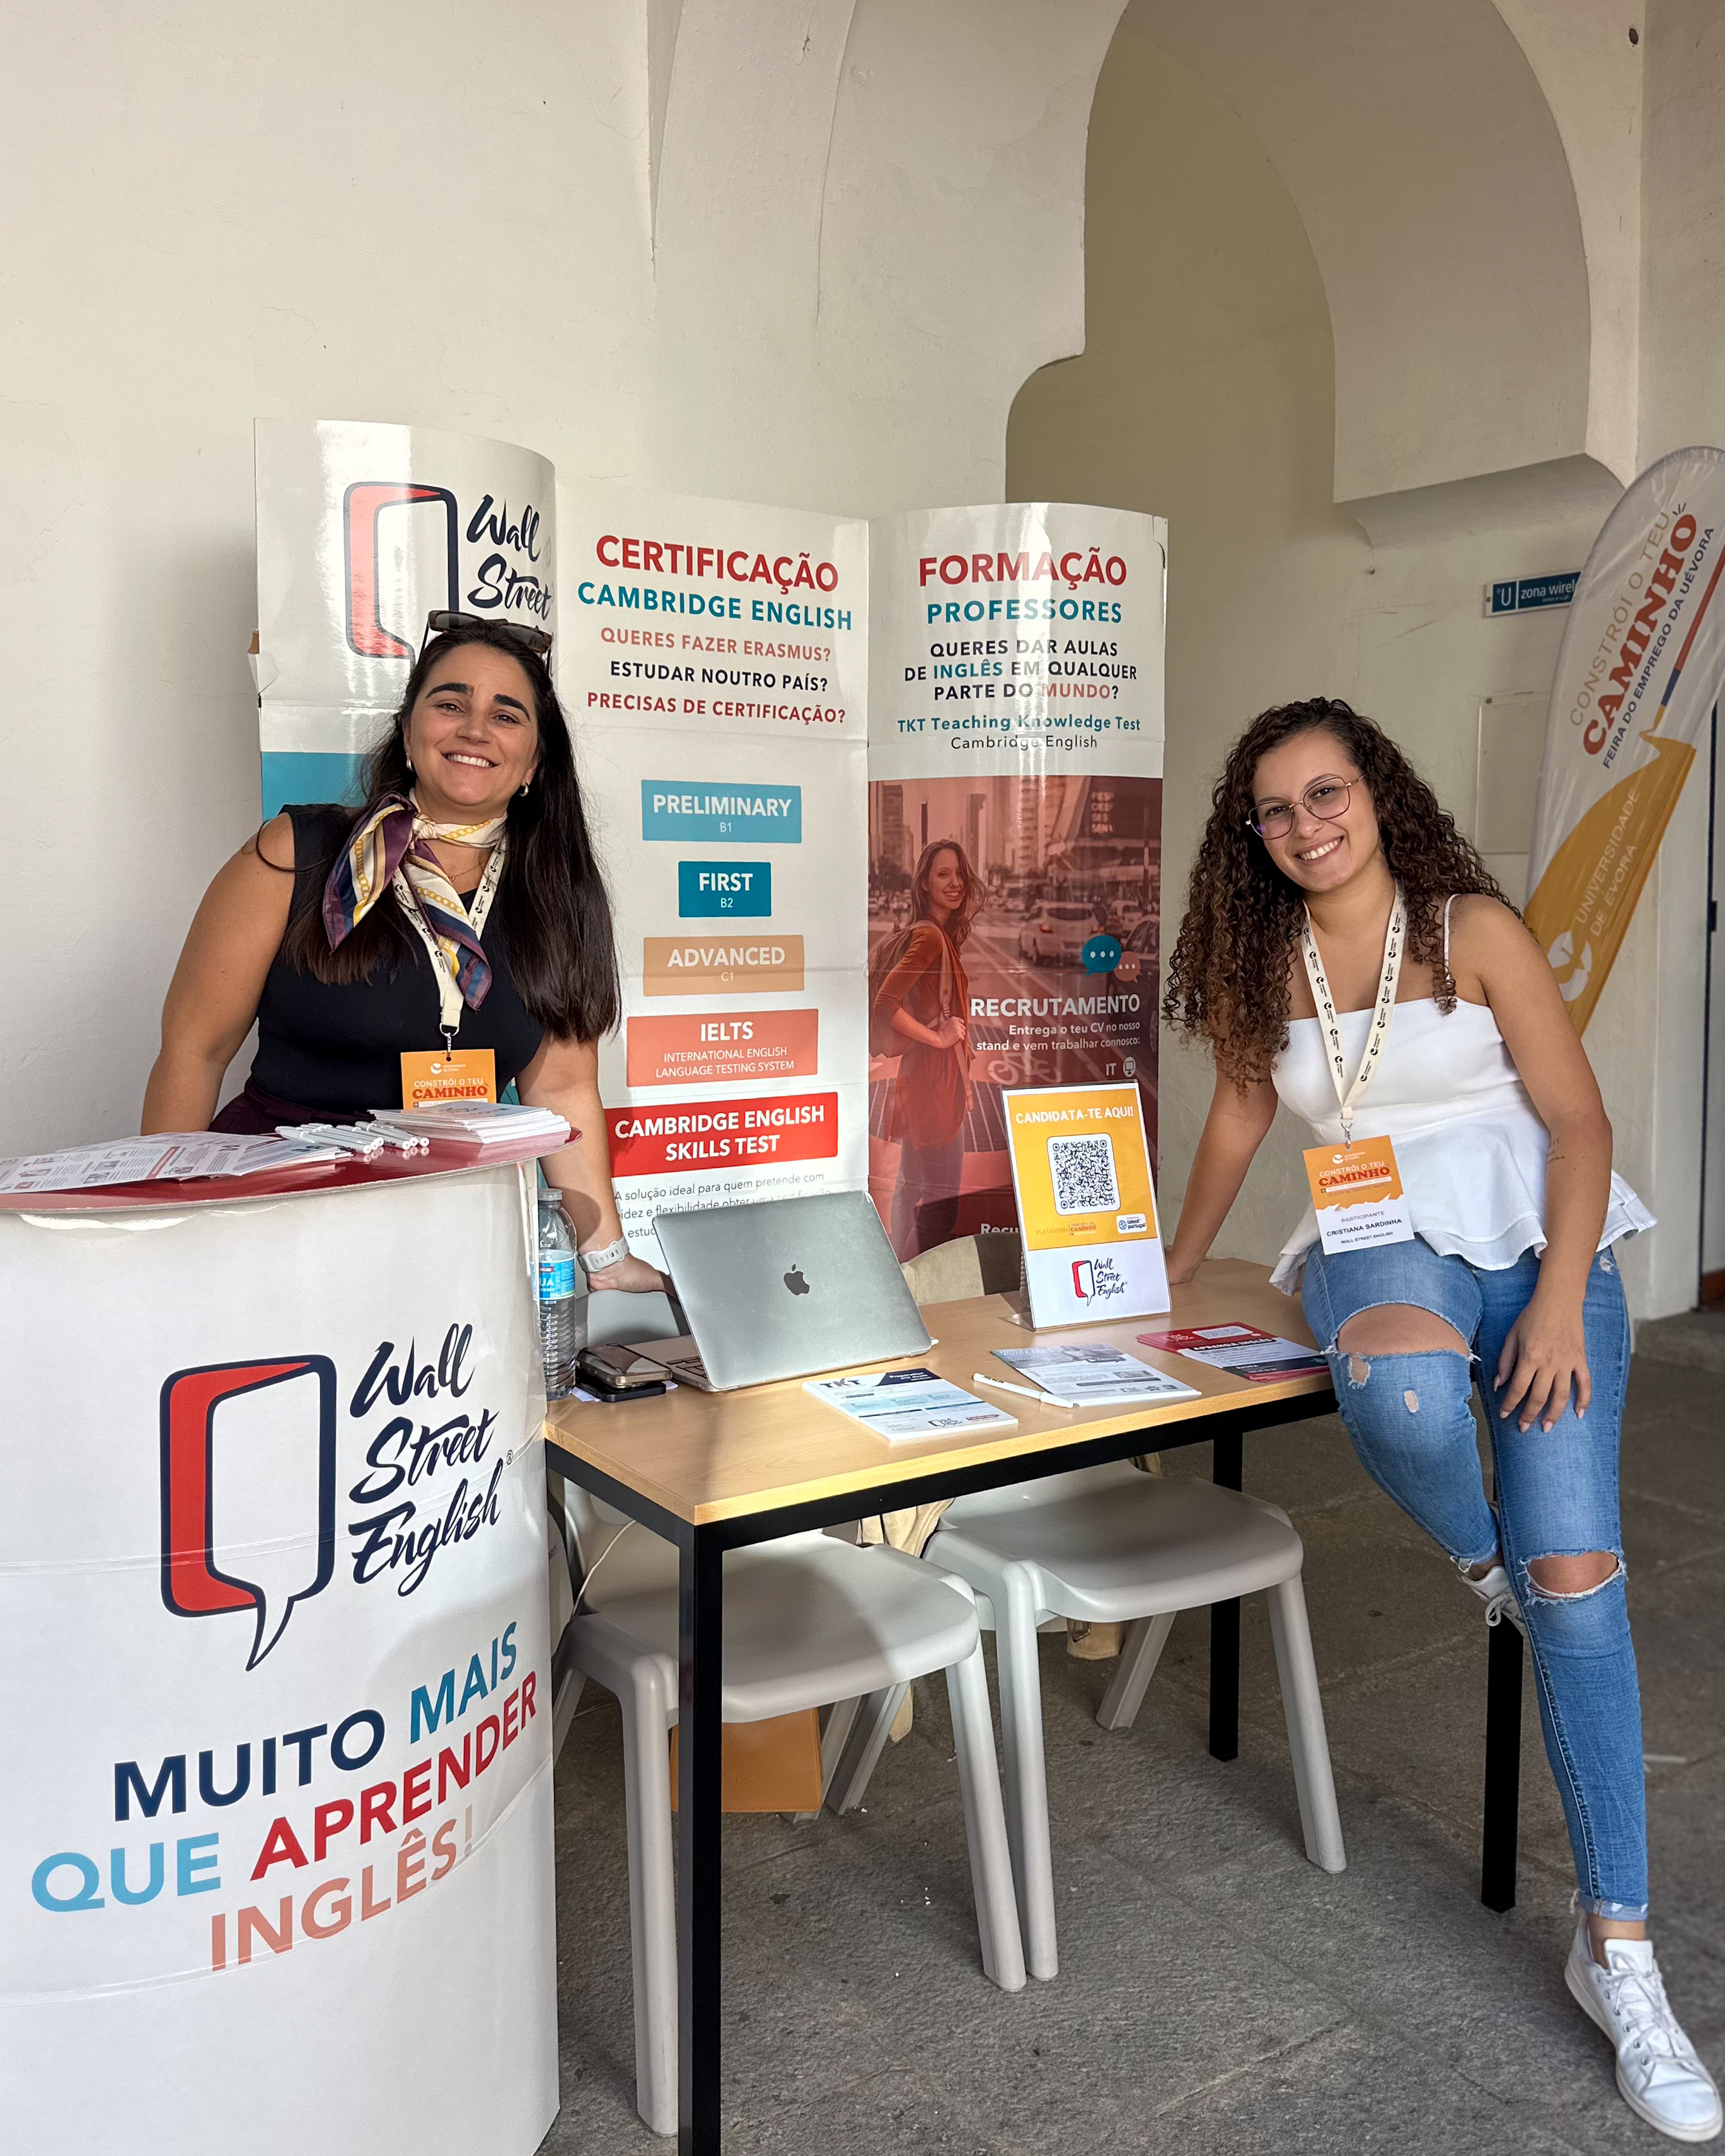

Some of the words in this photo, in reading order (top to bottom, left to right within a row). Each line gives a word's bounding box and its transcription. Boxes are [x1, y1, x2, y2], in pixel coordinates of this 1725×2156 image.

[466, 494, 541, 562] Wall
[596, 535, 838, 595] CERTIFICAÇÃO
[919, 546, 1127, 591] FORMAÇÃO
[468, 553, 553, 620] Street
[1521, 587, 1546, 599] zona
[1549, 579, 1577, 595] wirel
[578, 582, 741, 619] CAMBRIDGE
[752, 600, 851, 630] ENGLISH
[927, 598, 1122, 624] PROFESSORES
[1569, 596, 1634, 727] CONSTRÓI
[1628, 571, 1643, 589] O
[1638, 511, 1670, 562] TEU
[601, 627, 675, 648] QUERES
[682, 635, 737, 654] FAZER
[744, 641, 831, 662] ERASMUS?
[1583, 514, 1697, 756] CAMINHO
[930, 640, 1008, 657] QUERES
[1017, 640, 1058, 654] DAR
[1064, 640, 1117, 656] AULAS
[1602, 726, 1627, 769] FEIRA
[1622, 700, 1637, 724] DO
[1633, 623, 1672, 700] EMPREGO
[1668, 598, 1684, 621] DA
[1680, 527, 1714, 596] UÉVORA
[611, 661, 695, 682] ESTUDAR
[701, 669, 776, 688] NOUTRO
[783, 672, 828, 691] PAÍS?
[904, 667, 926, 681] DE
[934, 659, 1003, 679] INGLÊS
[1011, 661, 1040, 675] EM
[1048, 661, 1137, 680] QUALQUER
[935, 684, 995, 700] PARTE
[1003, 683, 1034, 698] DO
[1042, 683, 1119, 700] MUNDO?
[587, 692, 676, 712] PRECISAS
[683, 699, 706, 714] DE
[712, 700, 846, 725] CERTIFICAÇÃO?
[897, 718, 926, 732] TKT
[931, 714, 1011, 731] Teaching
[1017, 713, 1111, 732] Knowledge
[1115, 716, 1140, 731] Test
[950, 734, 1039, 750] Cambridge
[1046, 734, 1097, 751] English
[653, 794, 792, 817] PRELIMINARY
[720, 822, 732, 833] B1
[1576, 787, 1640, 925] UNIVERSIDADE
[699, 872, 753, 891] FIRST
[1590, 914, 1608, 937] DE
[1601, 844, 1637, 908] ÉVORA
[720, 897, 733, 908] B2
[667, 947, 785, 967] ADVANCED
[720, 971, 734, 982] C1
[971, 993, 1141, 1017] RECRUTAMENTO
[700, 1021, 754, 1042] IELTS
[1009, 1023, 1058, 1037] Entrega
[1070, 1024, 1088, 1034] teu
[1090, 1022, 1104, 1032] CV
[1119, 1022, 1140, 1030] nosso
[976, 1040, 1009, 1051] stand
[1023, 1042, 1048, 1051] vem
[1051, 1038, 1099, 1050] trabalhar
[1100, 1037, 1140, 1048] connosco:
[664, 1049, 744, 1063] INTERNATIONAL
[747, 1046, 787, 1058] ENGLISH
[655, 1064, 713, 1078] LANGUAGE
[715, 1062, 756, 1075] TESTING
[758, 1060, 795, 1072] SYSTEM
[1105, 1063, 1116, 1076] IT
[412, 1085, 488, 1099] CAMINHO
[413, 1078, 456, 1088] CONSTRÓI
[614, 1112, 740, 1139] CAMBRIDGE
[744, 1105, 824, 1127] ENGLISH
[1015, 1107, 1102, 1124] CANDIDATA-TE
[1104, 1105, 1134, 1119] AQUI!
[665, 1138, 731, 1162] SKILLS
[734, 1134, 781, 1156] TEST
[1318, 1167, 1390, 1186] CAMINHO
[1319, 1164, 1359, 1177] CONSTRÓI
[614, 1191, 623, 1201] A
[625, 1187, 667, 1202] solução
[669, 1184, 695, 1197] ideal
[698, 1183, 721, 1198] para
[724, 1180, 753, 1194] quem
[756, 1175, 801, 1191] pretende
[804, 1172, 824, 1183] com
[617, 1206, 643, 1220] idez
[646, 1209, 653, 1218] e
[1341, 1211, 1385, 1223] PARTICIPANTE
[1327, 1225, 1364, 1237] CRISTIANA
[1365, 1218, 1402, 1230] SARDINHA
[1094, 1257, 1114, 1270] Wall
[1096, 1271, 1122, 1284] Street
[350, 1323, 476, 1418] Wall
[819, 1378, 862, 1388] TKT
[349, 1408, 500, 1504] Street
[114, 1709, 386, 1821] MUITO
[410, 1621, 518, 1744] MAIS
[32, 1833, 221, 1913] QUE
[250, 1671, 537, 1881] APRENDER
[211, 1806, 474, 1972] INGLÊS!
